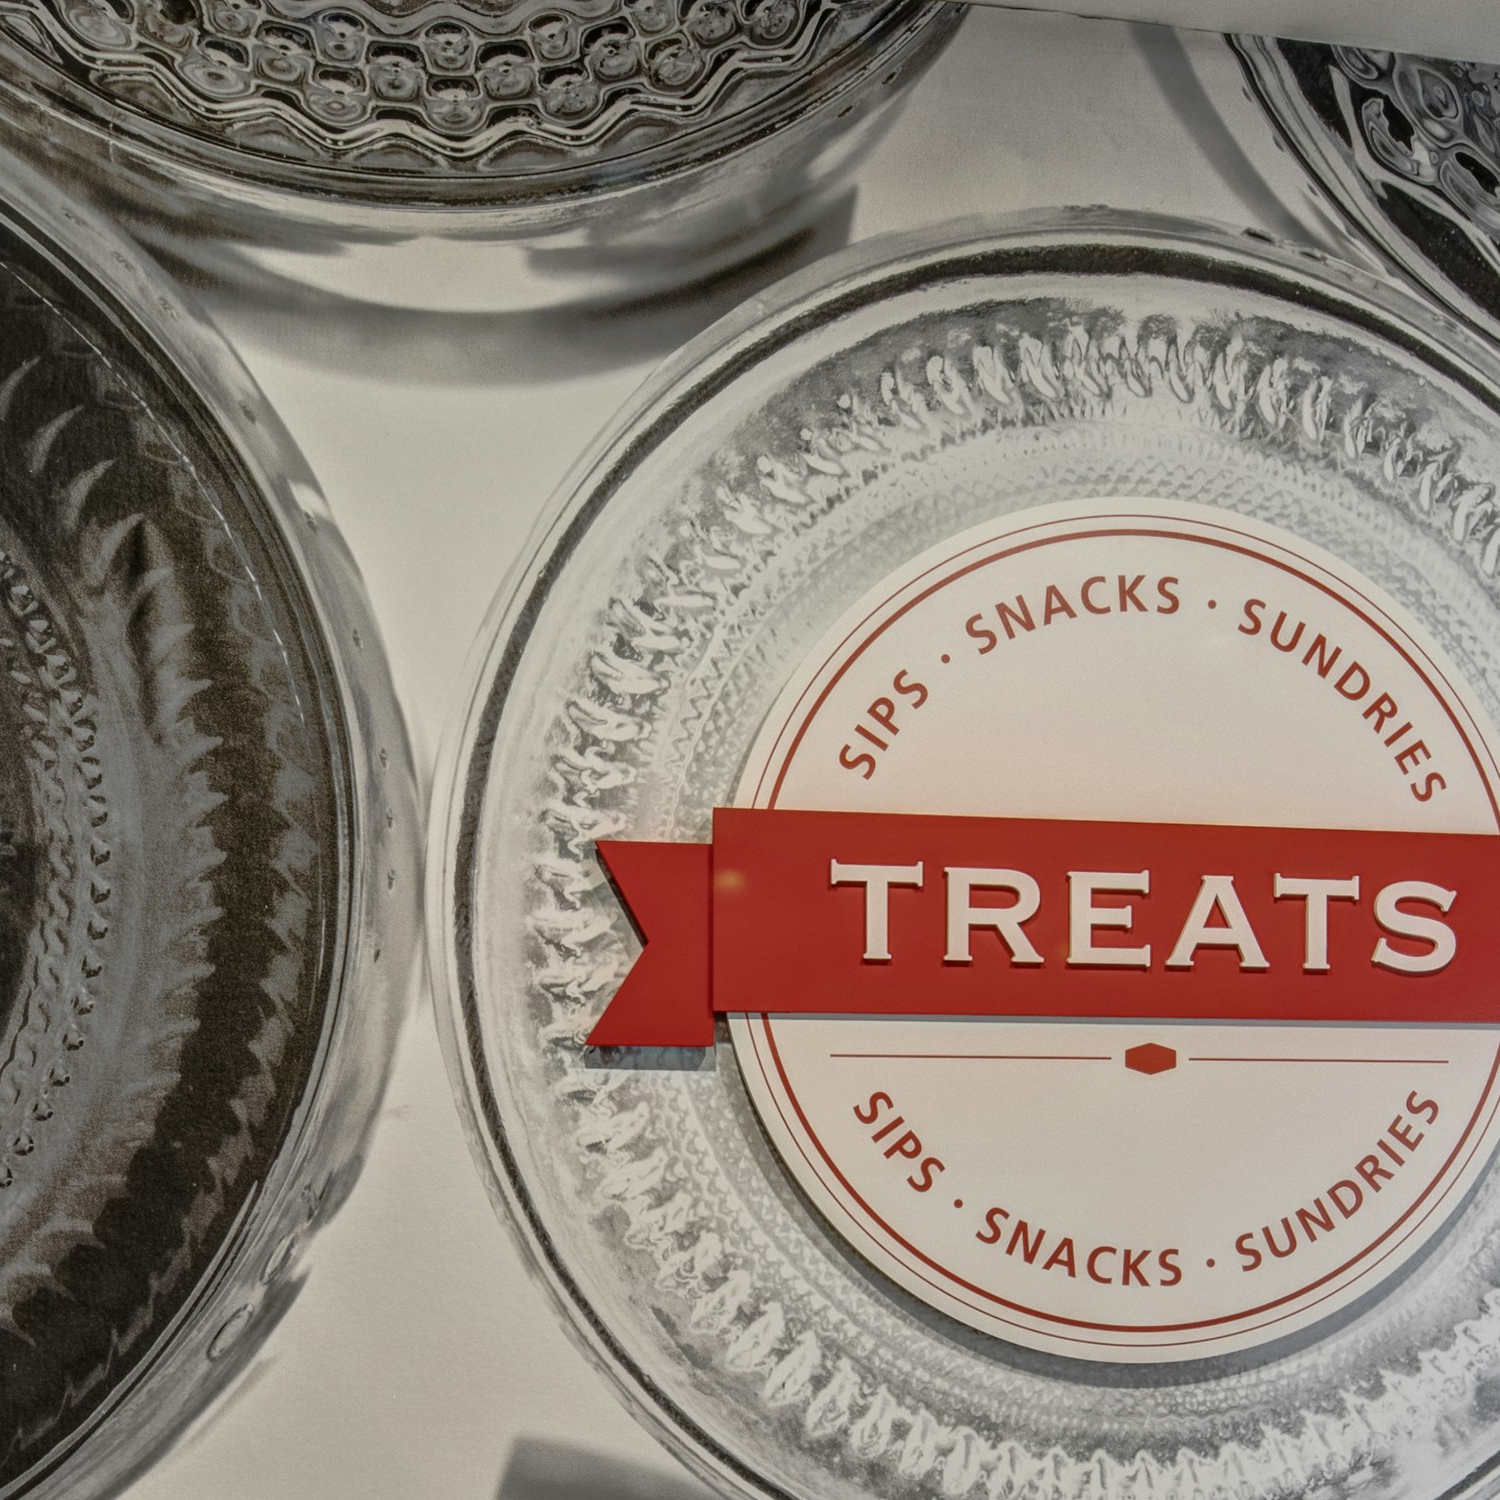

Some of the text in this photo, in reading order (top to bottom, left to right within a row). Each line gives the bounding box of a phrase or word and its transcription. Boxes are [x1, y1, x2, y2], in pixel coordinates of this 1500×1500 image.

[838, 574, 1448, 803] SIPS SNACKS SUNDRIES
[828, 859, 1458, 974] TREATS
[852, 1089, 1440, 1287] SIPS SNACKS SUNDRIES
